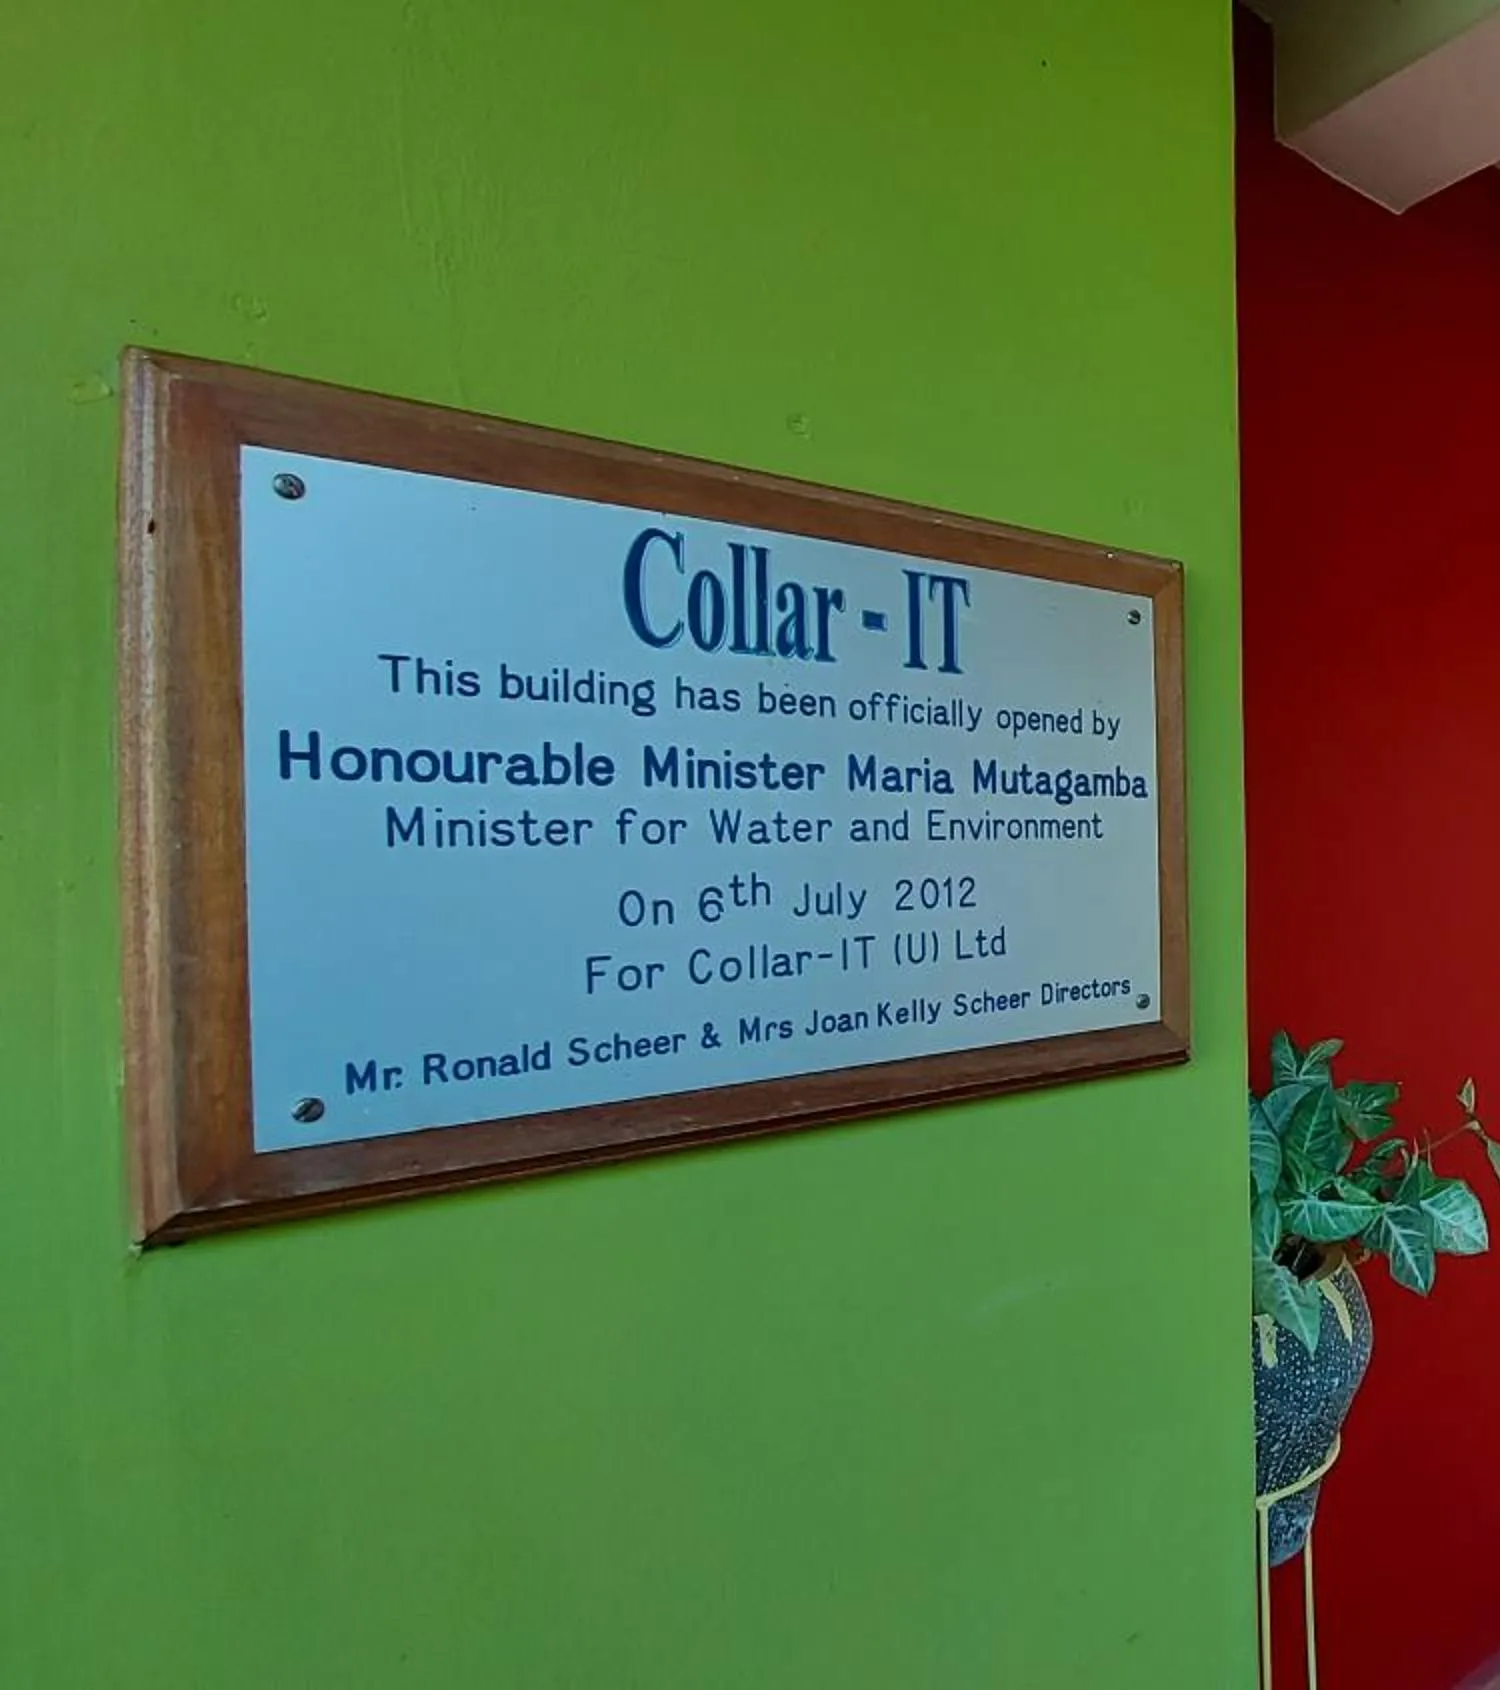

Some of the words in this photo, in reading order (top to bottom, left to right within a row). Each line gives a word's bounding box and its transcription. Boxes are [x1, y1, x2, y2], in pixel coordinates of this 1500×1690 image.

[623, 526, 846, 663] Collar
[902, 568, 971, 675] IT
[377, 653, 481, 697] This
[499, 662, 657, 718] building
[675, 676, 741, 713] has
[758, 682, 837, 719] been
[848, 691, 983, 733] officially
[996, 707, 1083, 739] opened
[1091, 709, 1121, 741] by
[279, 729, 615, 787] Honourable
[643, 744, 826, 791] Minister
[847, 753, 955, 795] Maria
[973, 759, 1149, 805] Mutagamba
[386, 805, 593, 849] Minister
[615, 807, 688, 845] for
[709, 808, 833, 845] Water
[849, 809, 910, 843] and
[927, 808, 1105, 841] Environment
[618, 889, 675, 927] On
[698, 871, 771, 923] 6th
[793, 881, 867, 921] July
[895, 875, 977, 912] 2012
[585, 955, 665, 995] For
[688, 935, 876, 985] Collar-IT
[894, 930, 939, 966] (U)
[955, 925, 1007, 961] Ltd
[345, 1059, 403, 1096] Mr.
[423, 1040, 552, 1086] Ronald
[567, 1032, 687, 1067] Scheer
[700, 1021, 722, 1050] &
[739, 1015, 794, 1045] Mrs
[804, 1009, 869, 1037] Joan
[877, 997, 942, 1028] Kelly
[953, 989, 1031, 1017] Scheer
[1041, 978, 1131, 1007] Directors
